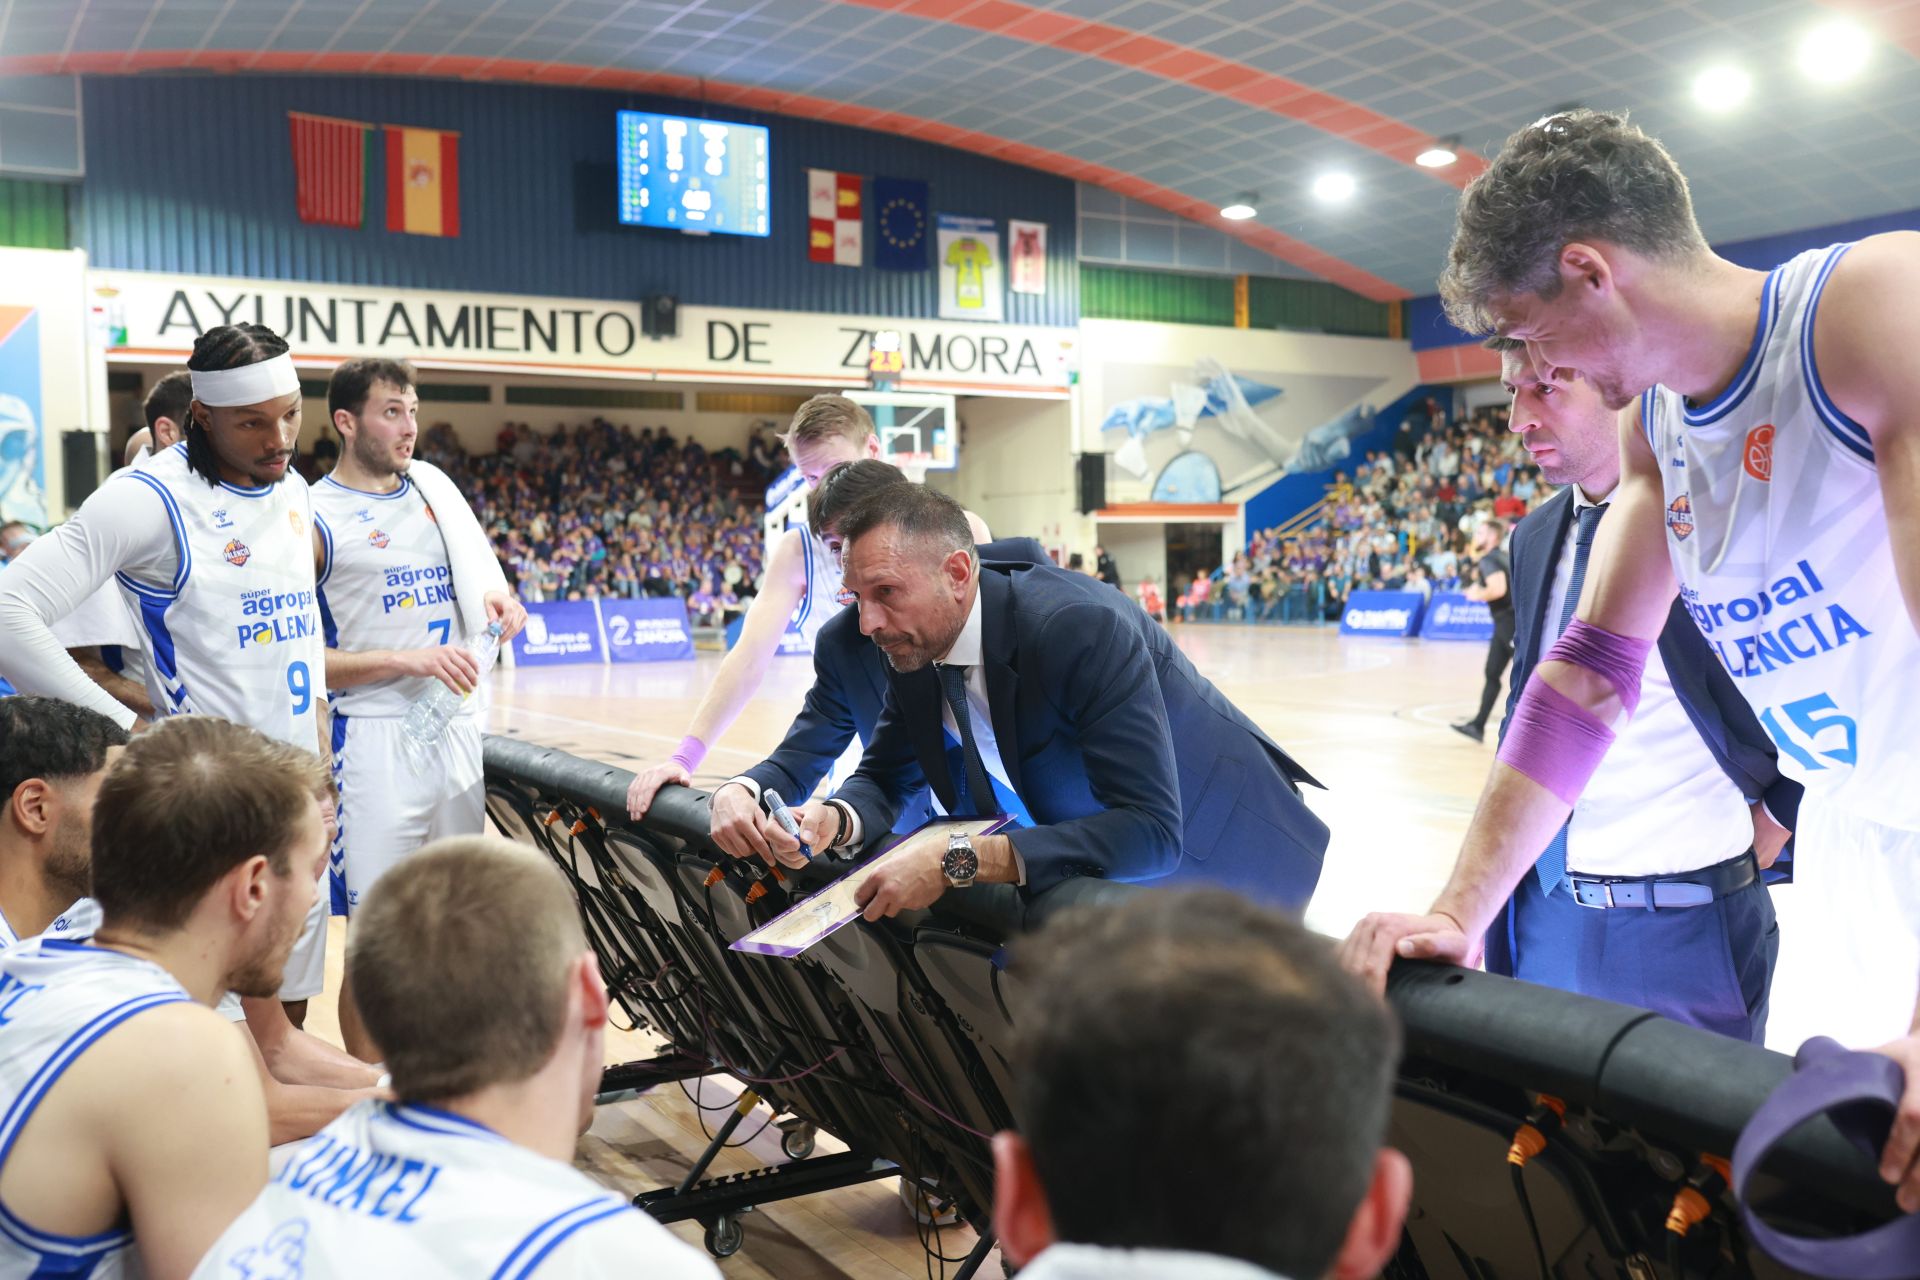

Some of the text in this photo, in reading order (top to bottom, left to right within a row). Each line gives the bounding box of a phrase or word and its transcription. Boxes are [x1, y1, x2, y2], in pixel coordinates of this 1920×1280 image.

[157, 289, 636, 357] AYUNTAMIENTO
[707, 320, 772, 365] DE
[839, 327, 1042, 376] ZMORA
[428, 618, 451, 646] 7
[286, 660, 311, 716] 9
[1759, 692, 1858, 771] 15
